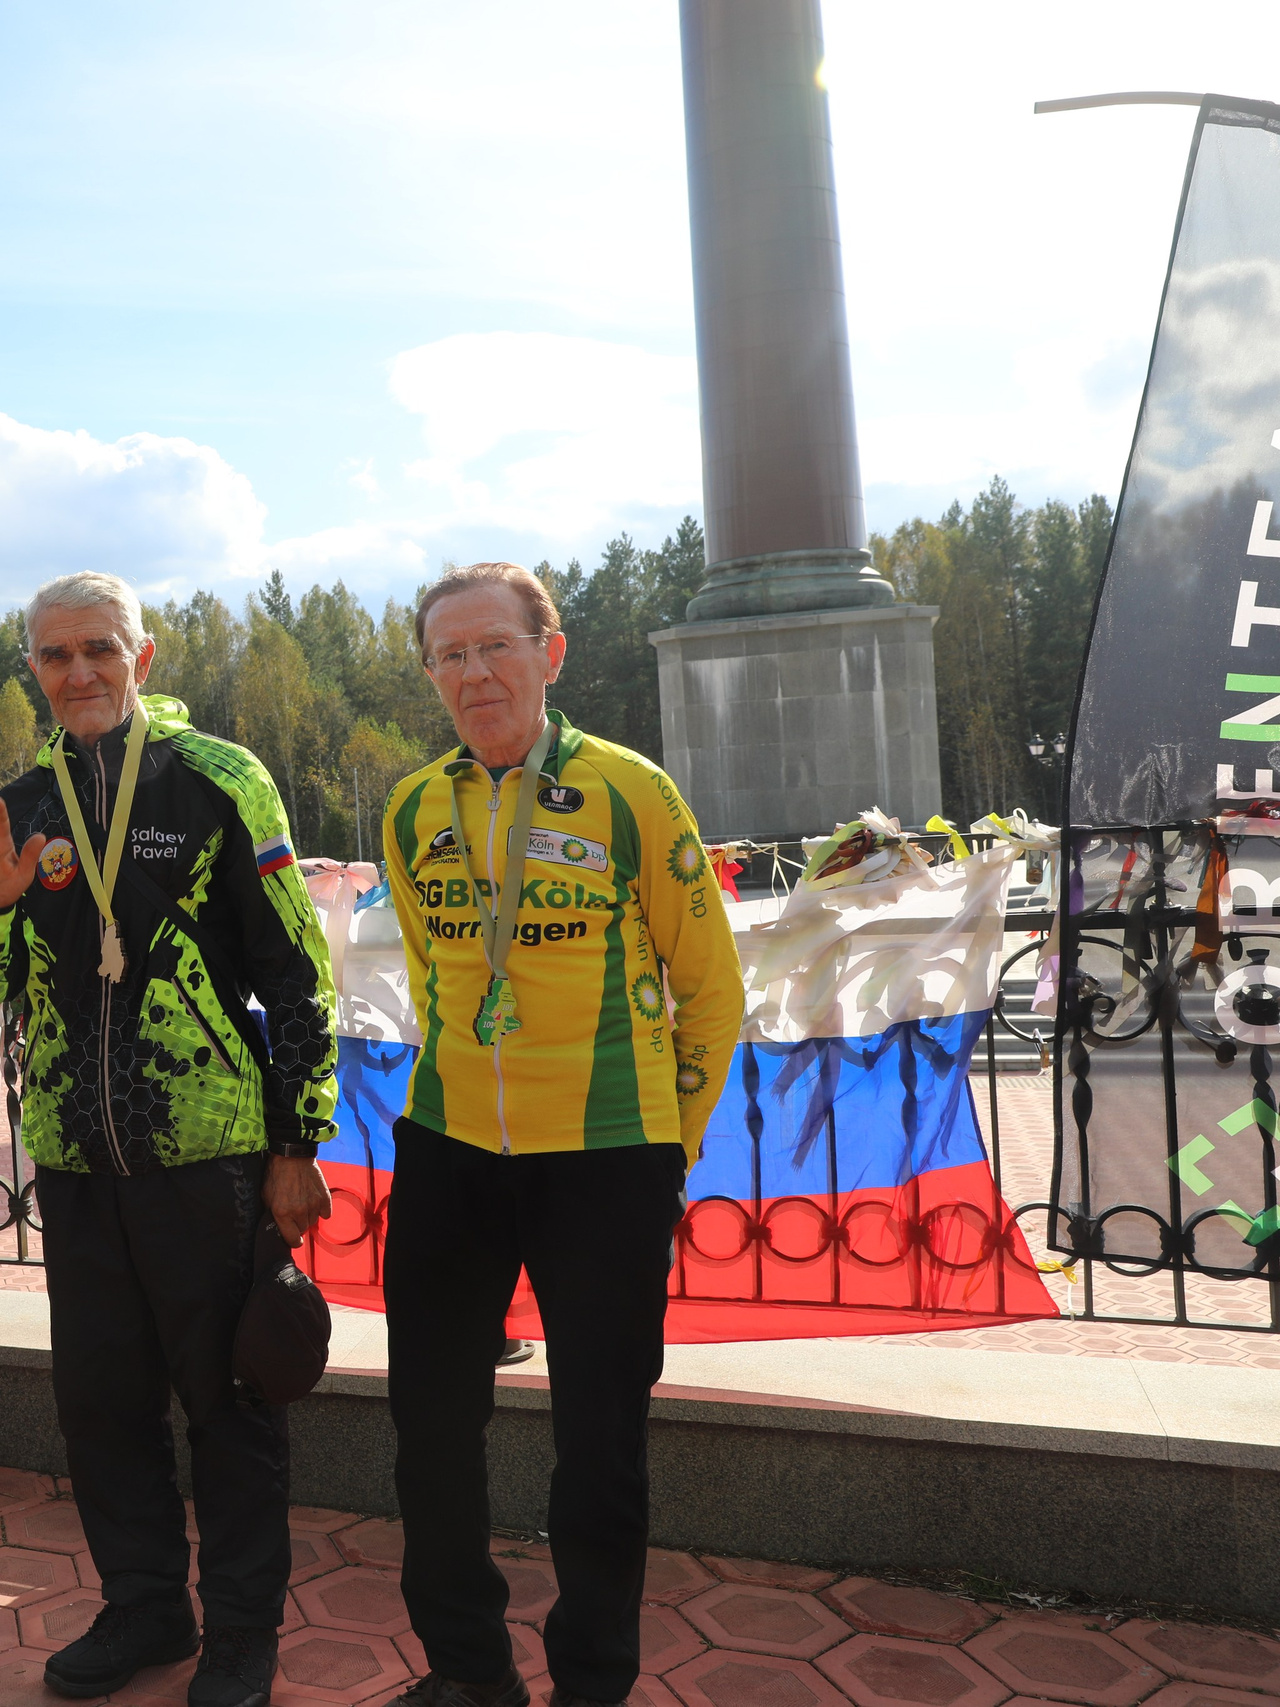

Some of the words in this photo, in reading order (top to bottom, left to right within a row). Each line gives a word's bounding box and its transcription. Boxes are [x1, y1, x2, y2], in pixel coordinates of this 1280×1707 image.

[131, 826, 187, 844] Salaev
[133, 844, 178, 859] Pavel
[529, 838, 554, 851] Köln
[591, 850, 605, 862] bp
[689, 887, 707, 918] bp
[424, 915, 587, 947] Worrgen
[649, 1026, 664, 1053] bp
[687, 1045, 710, 1062] bp
